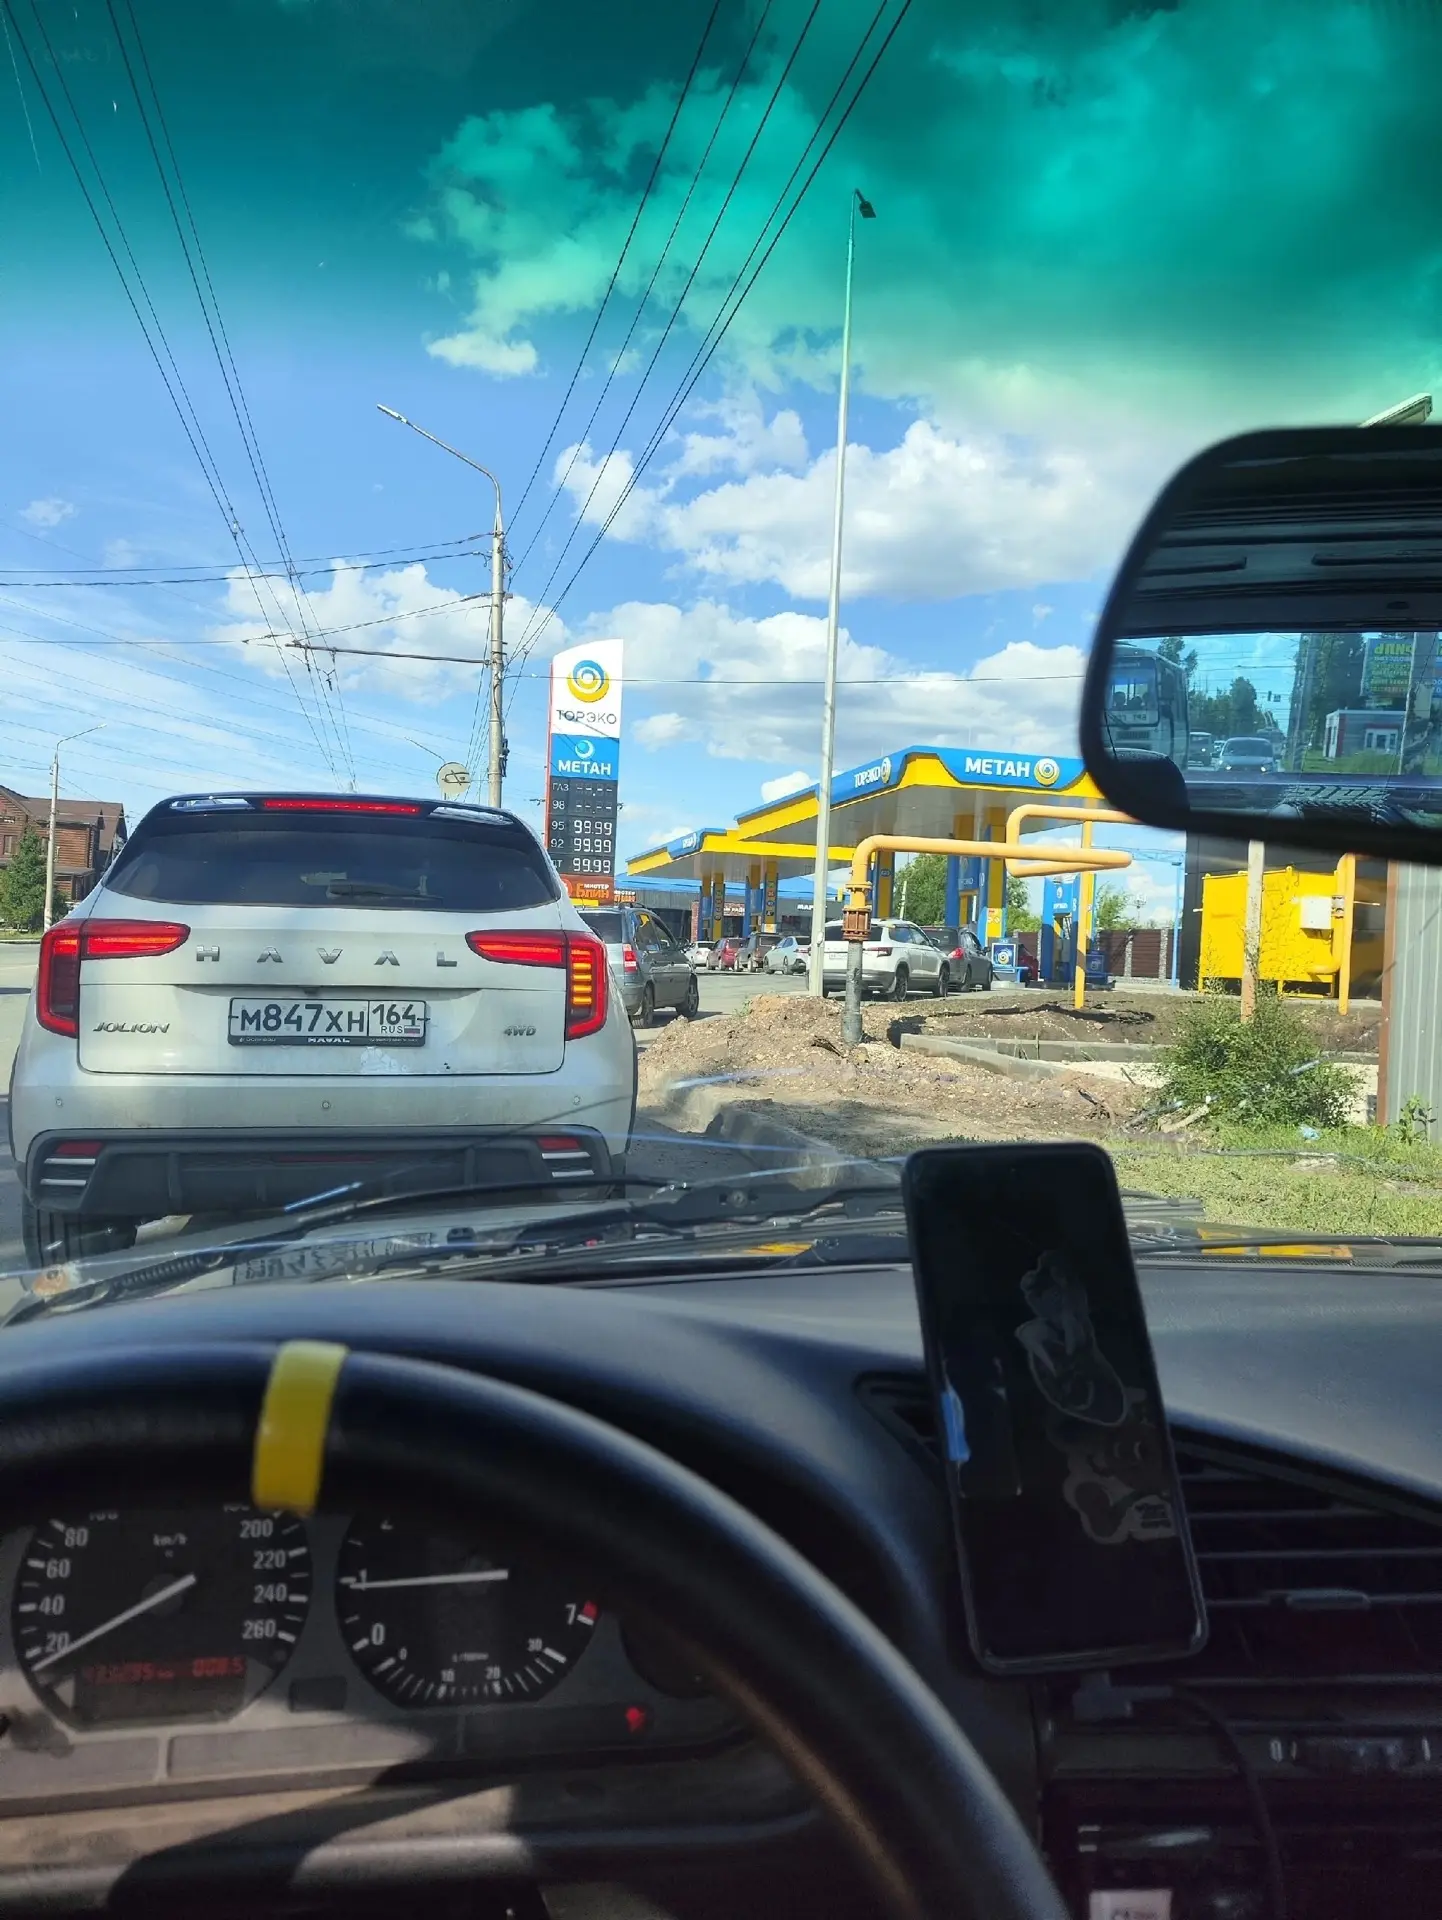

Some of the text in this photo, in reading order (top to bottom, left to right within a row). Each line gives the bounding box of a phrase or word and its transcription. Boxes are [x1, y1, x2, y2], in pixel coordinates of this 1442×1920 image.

[556, 709, 617, 724] ТОРЭКО
[558, 759, 612, 775] МЕТАН
[965, 757, 1030, 777] МЕТАН
[854, 766, 881, 788] ТОРЭКО
[552, 782, 569, 792] ГАЗ
[552, 800, 565, 810] 98
[551, 820, 613, 836] 95 99.99
[550, 837, 612, 853] 92 99.99
[572, 857, 611, 874] 99.99
[196, 945, 458, 968] HAVAL
[240, 1004, 365, 1033] М847ХН
[372, 1004, 417, 1026] 164
[92, 1022, 170, 1034] JOLION
[380, 1025, 403, 1034] RUS
[503, 1025, 537, 1037] 4WD
[65, 1528, 88, 1547] 80
[240, 1519, 273, 1539] 200
[46, 1559, 70, 1578] 60
[253, 1550, 286, 1570] 220
[254, 1584, 287, 1604] 240
[39, 1594, 64, 1615] 40
[566, 1603, 577, 1625] 7
[242, 1619, 276, 1640] 260
[371, 1623, 385, 1646] 0
[44, 1632, 70, 1652] 20
[441, 1669, 455, 1682] 10
[486, 1666, 501, 1680] 20
